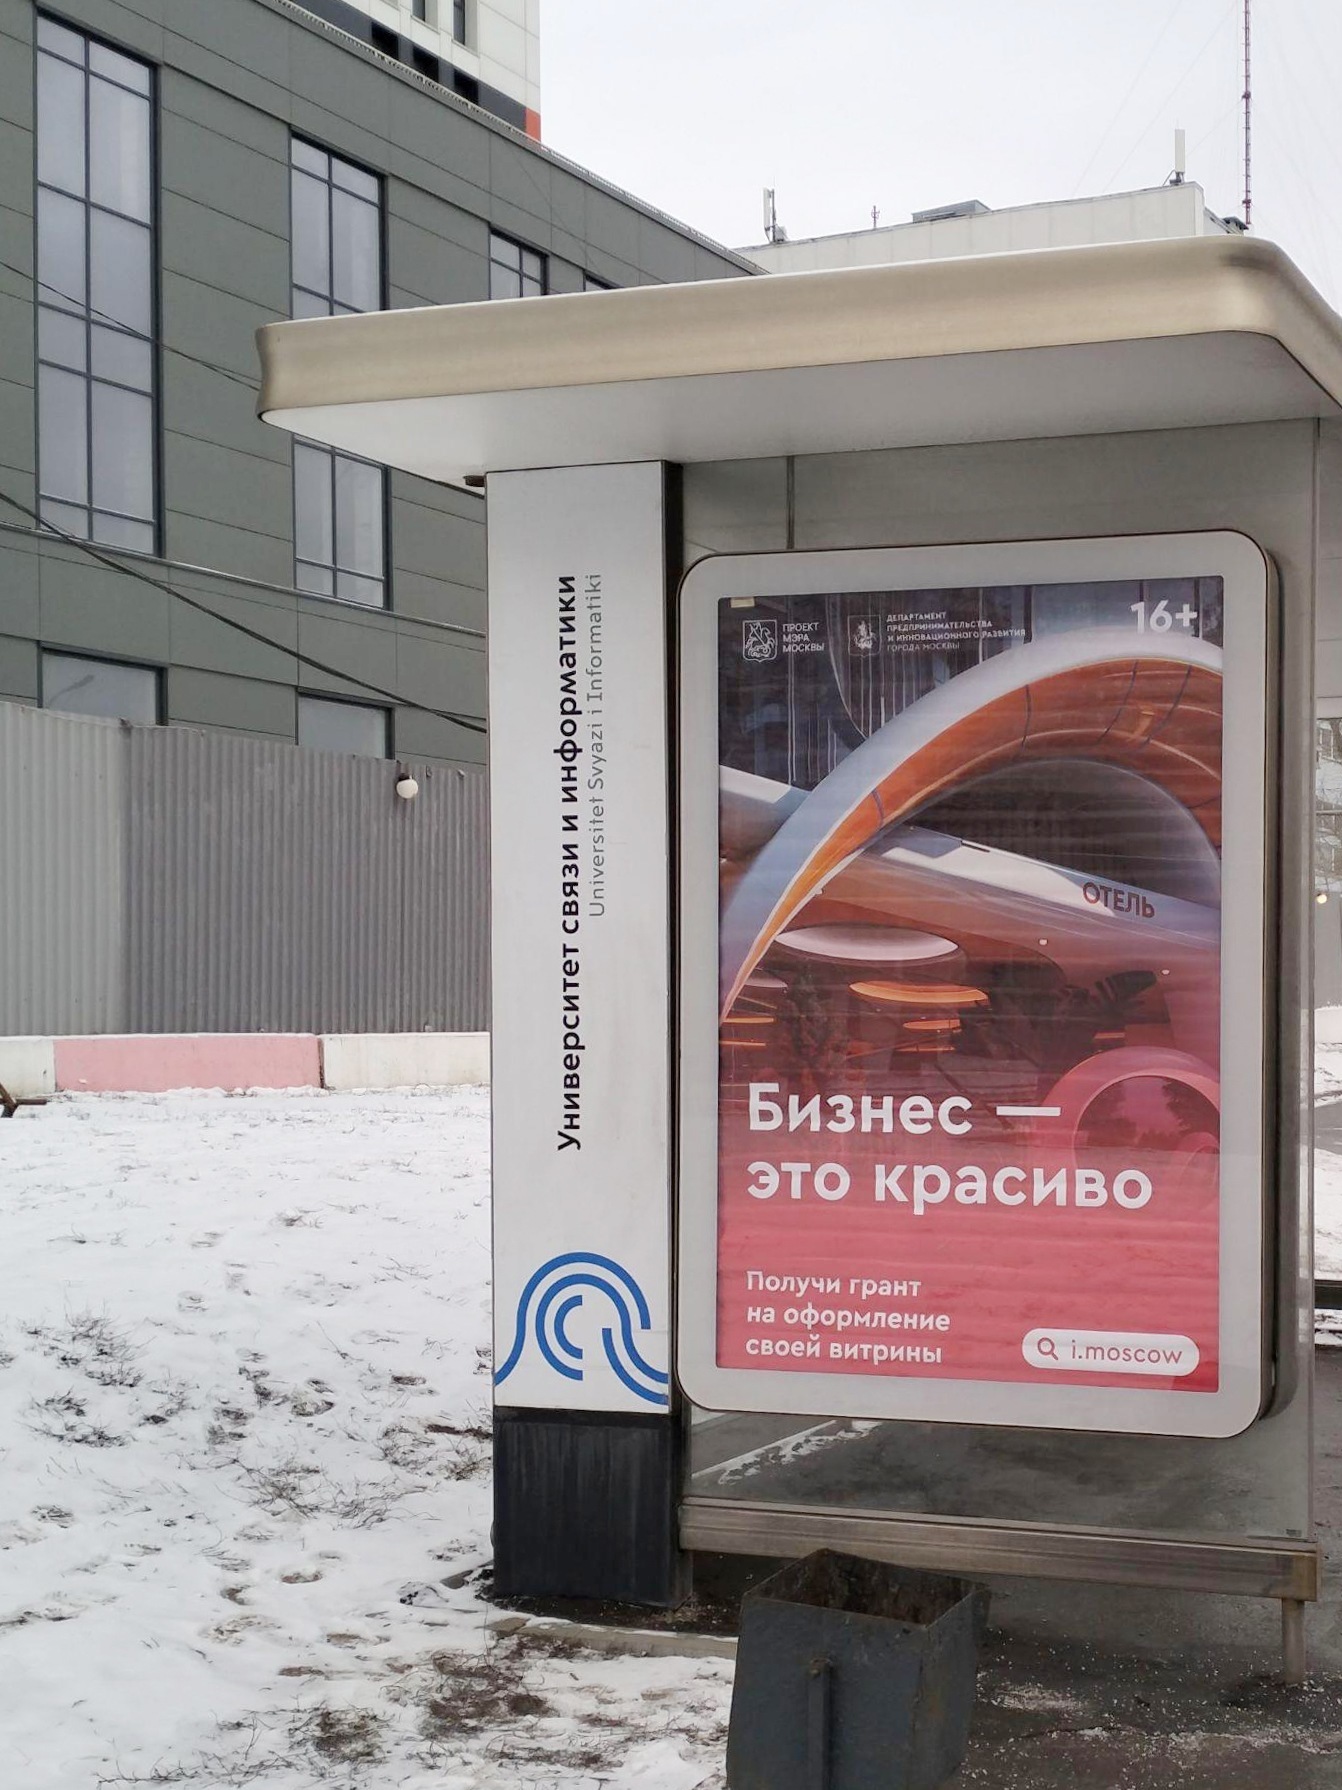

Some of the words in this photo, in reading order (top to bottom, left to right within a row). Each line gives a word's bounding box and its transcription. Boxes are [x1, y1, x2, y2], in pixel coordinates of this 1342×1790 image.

[782, 622, 820, 632] ПРОЕКТ
[886, 611, 947, 622] ДЕПАРТАМЕНТ
[886, 620, 993, 632] ПРЕДПРИНИМАТЕЛЬСТВА
[1130, 600, 1198, 635] 16+
[584, 574, 603, 702] Informatiki
[782, 633, 811, 643] МЭРА
[782, 643, 825, 653] МОСКВЫ
[886, 642, 921, 652] ГОРОДА
[922, 641, 961, 651] МОСКВЫ
[896, 630, 980, 642] ИННОВАЦИОННОГО
[982, 628, 1026, 639] РАЗВИТИЯ
[553, 575, 583, 802] информатики
[587, 723, 607, 790] Svyazi
[561, 813, 579, 832] и
[588, 797, 605, 918] Universitet
[562, 843, 580, 934] связи
[1083, 881, 1155, 918] ОТЕЛЬ
[556, 943, 585, 1151] Университет
[748, 1082, 973, 1135] Бизнес
[747, 1161, 851, 1200] это
[875, 1164, 1153, 1216] красиво
[746, 1271, 841, 1298] Получи
[850, 1278, 922, 1300] грант
[747, 1306, 776, 1324] на
[783, 1302, 951, 1332] оформление
[745, 1333, 821, 1359] своей
[829, 1341, 942, 1365] витрины
[1071, 1339, 1183, 1365] i.moscow
